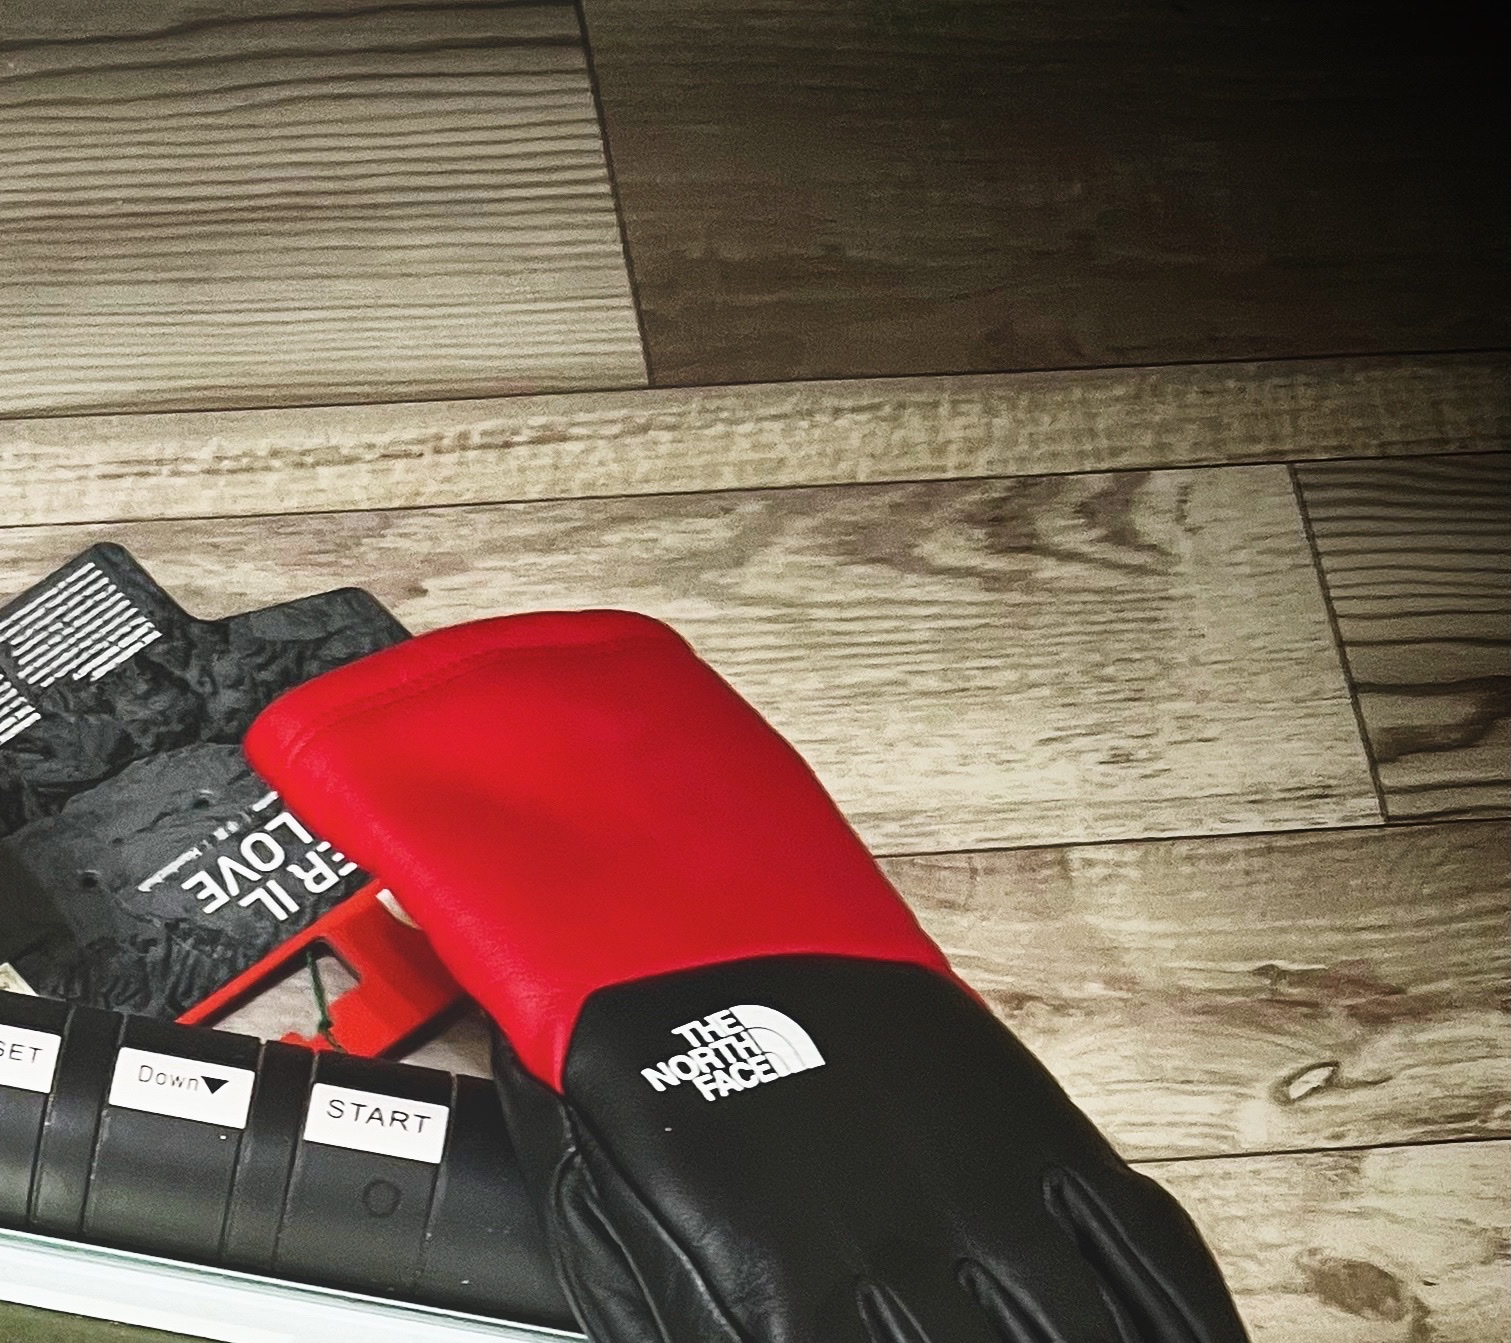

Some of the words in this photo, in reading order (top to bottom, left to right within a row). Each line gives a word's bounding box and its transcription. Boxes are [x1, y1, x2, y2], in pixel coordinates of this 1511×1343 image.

[671, 1009, 745, 1047] THE
[137, 1064, 199, 1092] Down
[640, 1031, 763, 1091] NORTH
[692, 1055, 778, 1101] FACE
[326, 1098, 432, 1134] START
